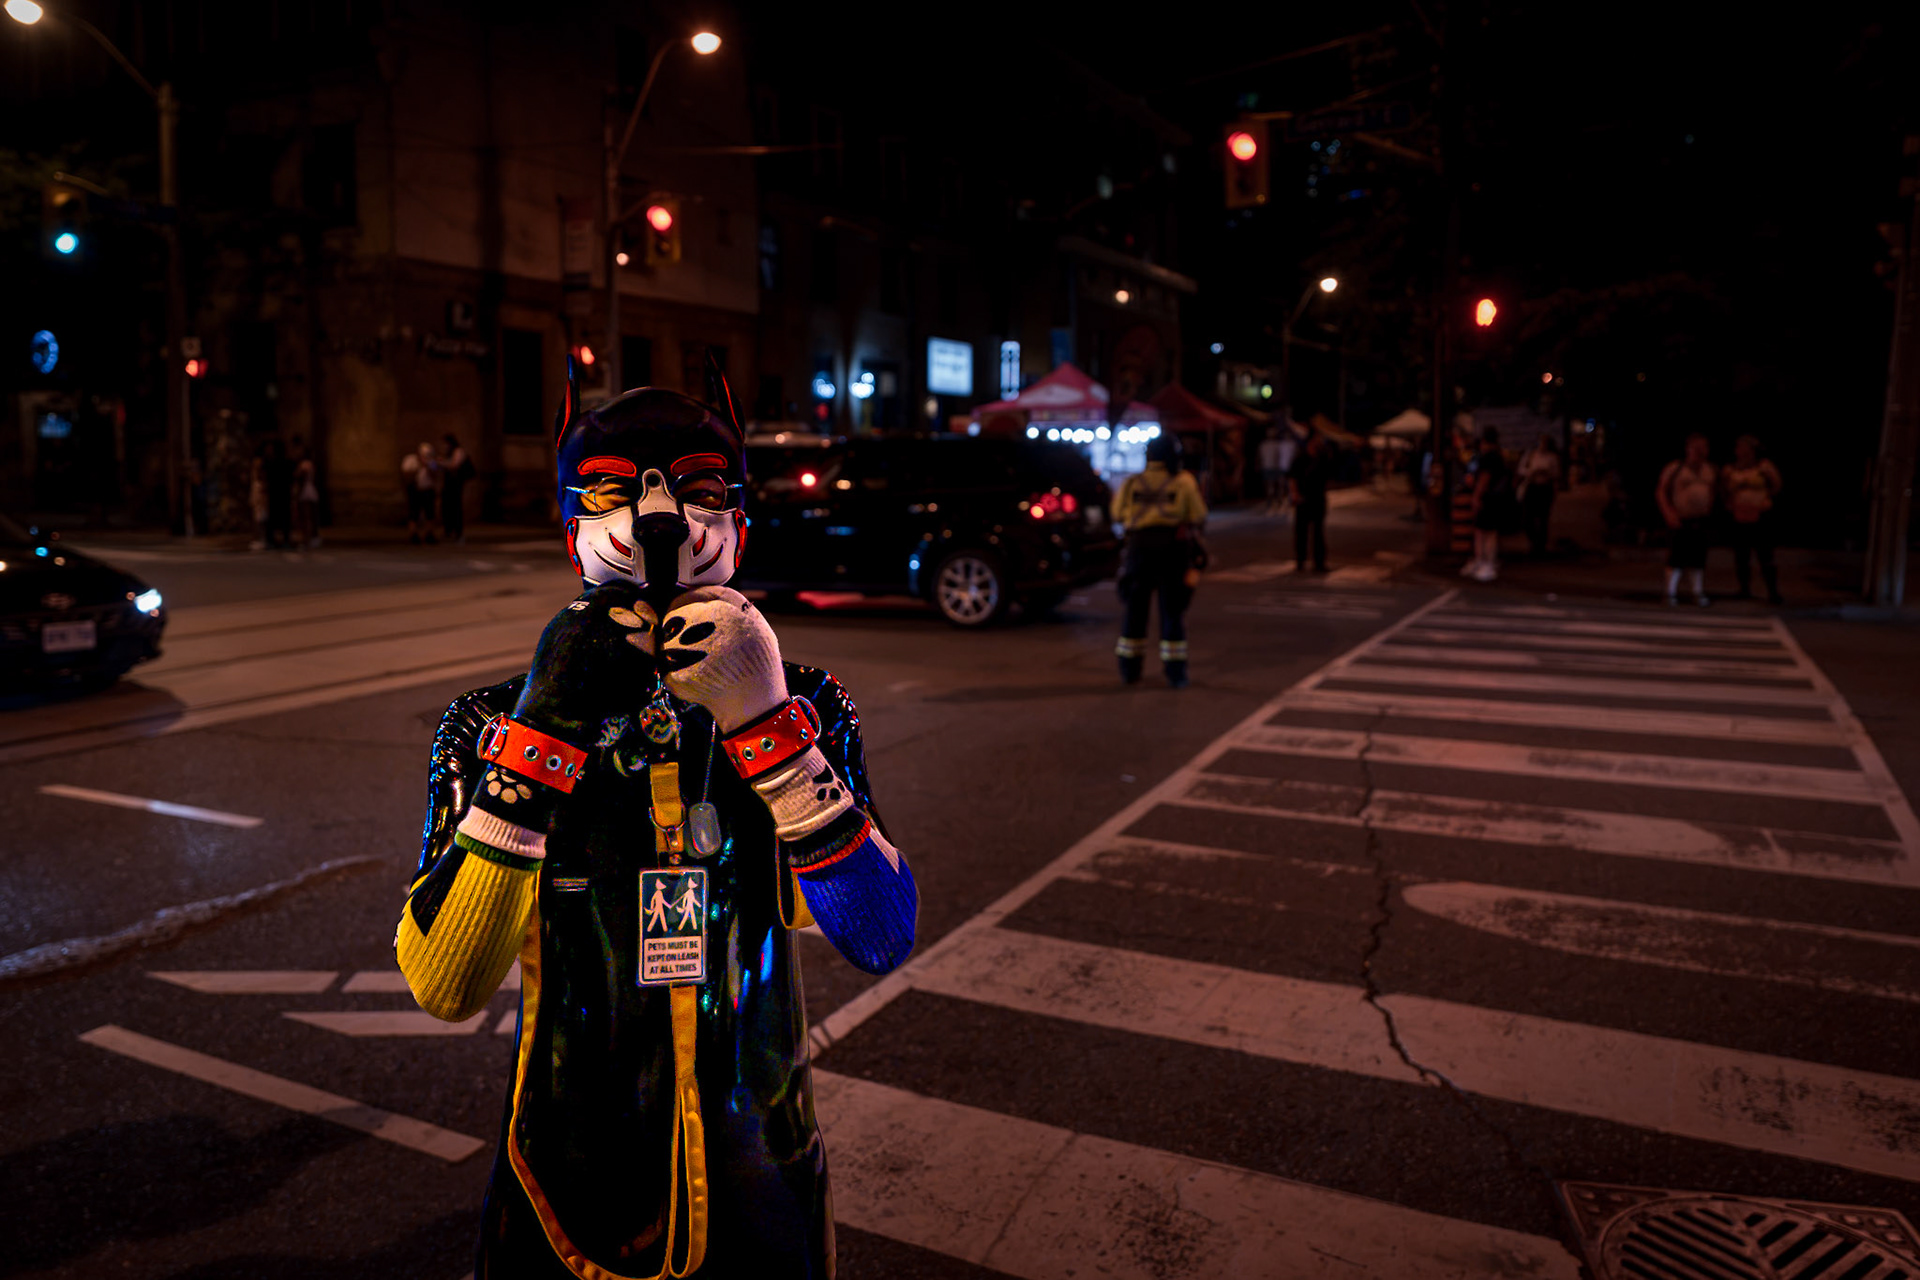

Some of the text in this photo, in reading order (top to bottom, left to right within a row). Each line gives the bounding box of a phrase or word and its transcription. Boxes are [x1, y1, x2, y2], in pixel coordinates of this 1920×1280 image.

[648, 940, 698, 951] PETS MUST BE
[647, 952, 699, 962] KEPT ON LEASH
[650, 963, 697, 974] AT ALL TIMES
